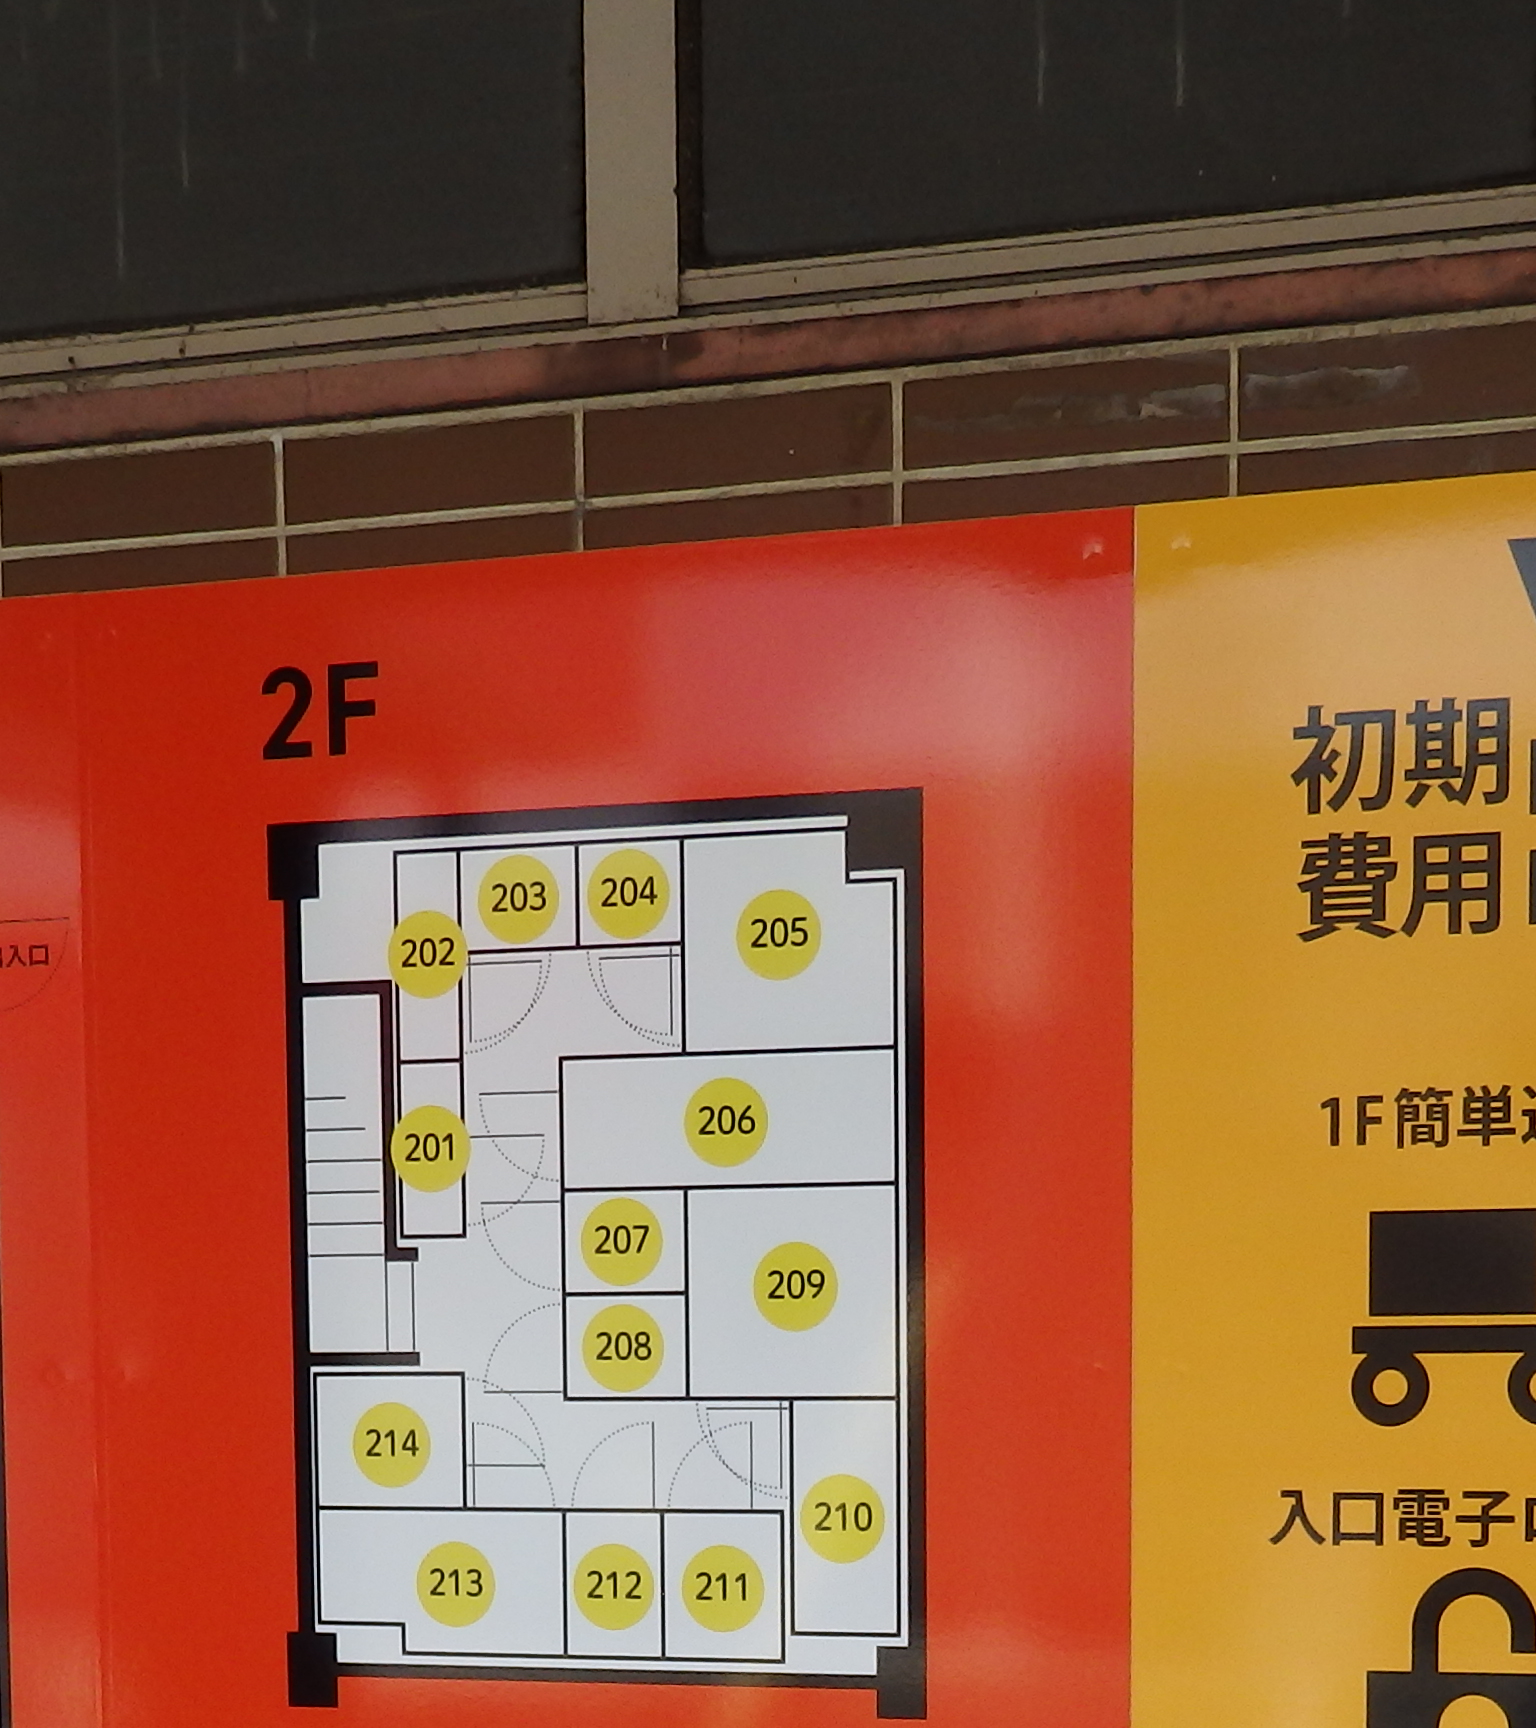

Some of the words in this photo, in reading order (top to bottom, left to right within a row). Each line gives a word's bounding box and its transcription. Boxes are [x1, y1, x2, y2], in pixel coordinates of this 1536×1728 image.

[262, 661, 378, 760] 2F
[1291, 698, 1510, 815] 初期
[492, 882, 546, 912] 203
[602, 876, 657, 907] 204
[1297, 831, 1501, 942] 費用
[751, 917, 808, 948] 205
[402, 938, 455, 967] 202
[699, 1105, 755, 1135] 206
[405, 1133, 453, 1161] 201
[595, 1225, 649, 1254] 207
[768, 1270, 825, 1299] 209
[597, 1332, 651, 1360] 208
[366, 1429, 419, 1456] 214
[815, 1502, 872, 1531] 210
[430, 1568, 482, 1597] 213
[588, 1571, 641, 1599] 212
[696, 1572, 746, 1601] 211
